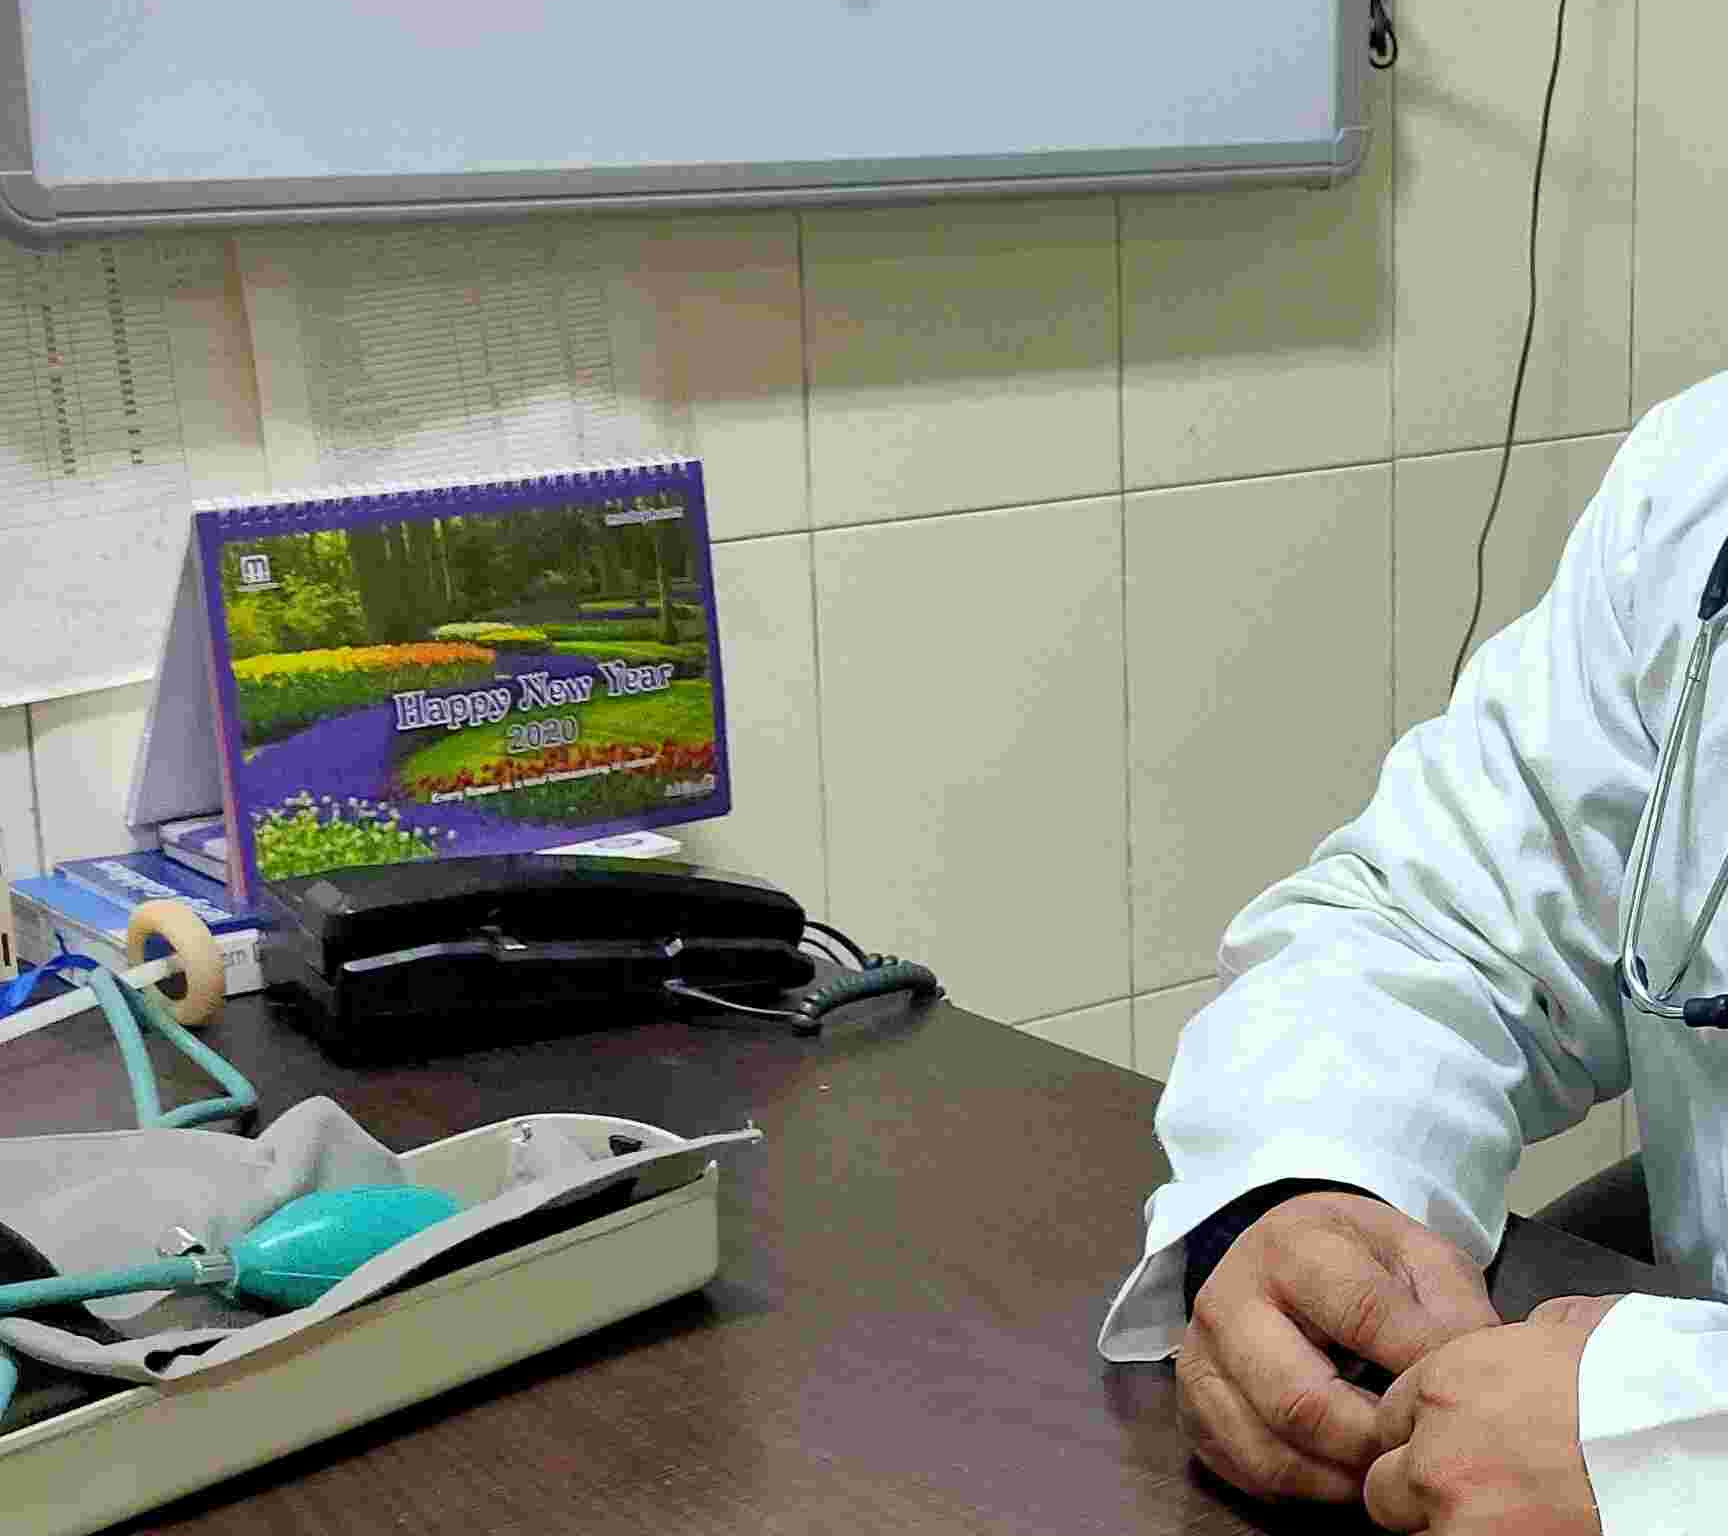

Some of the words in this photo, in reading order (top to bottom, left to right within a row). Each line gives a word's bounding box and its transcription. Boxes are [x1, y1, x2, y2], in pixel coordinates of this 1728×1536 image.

[393, 686, 511, 730] Happy
[517, 671, 593, 711] New
[599, 660, 674, 696] Year
[508, 716, 578, 753] 2020
